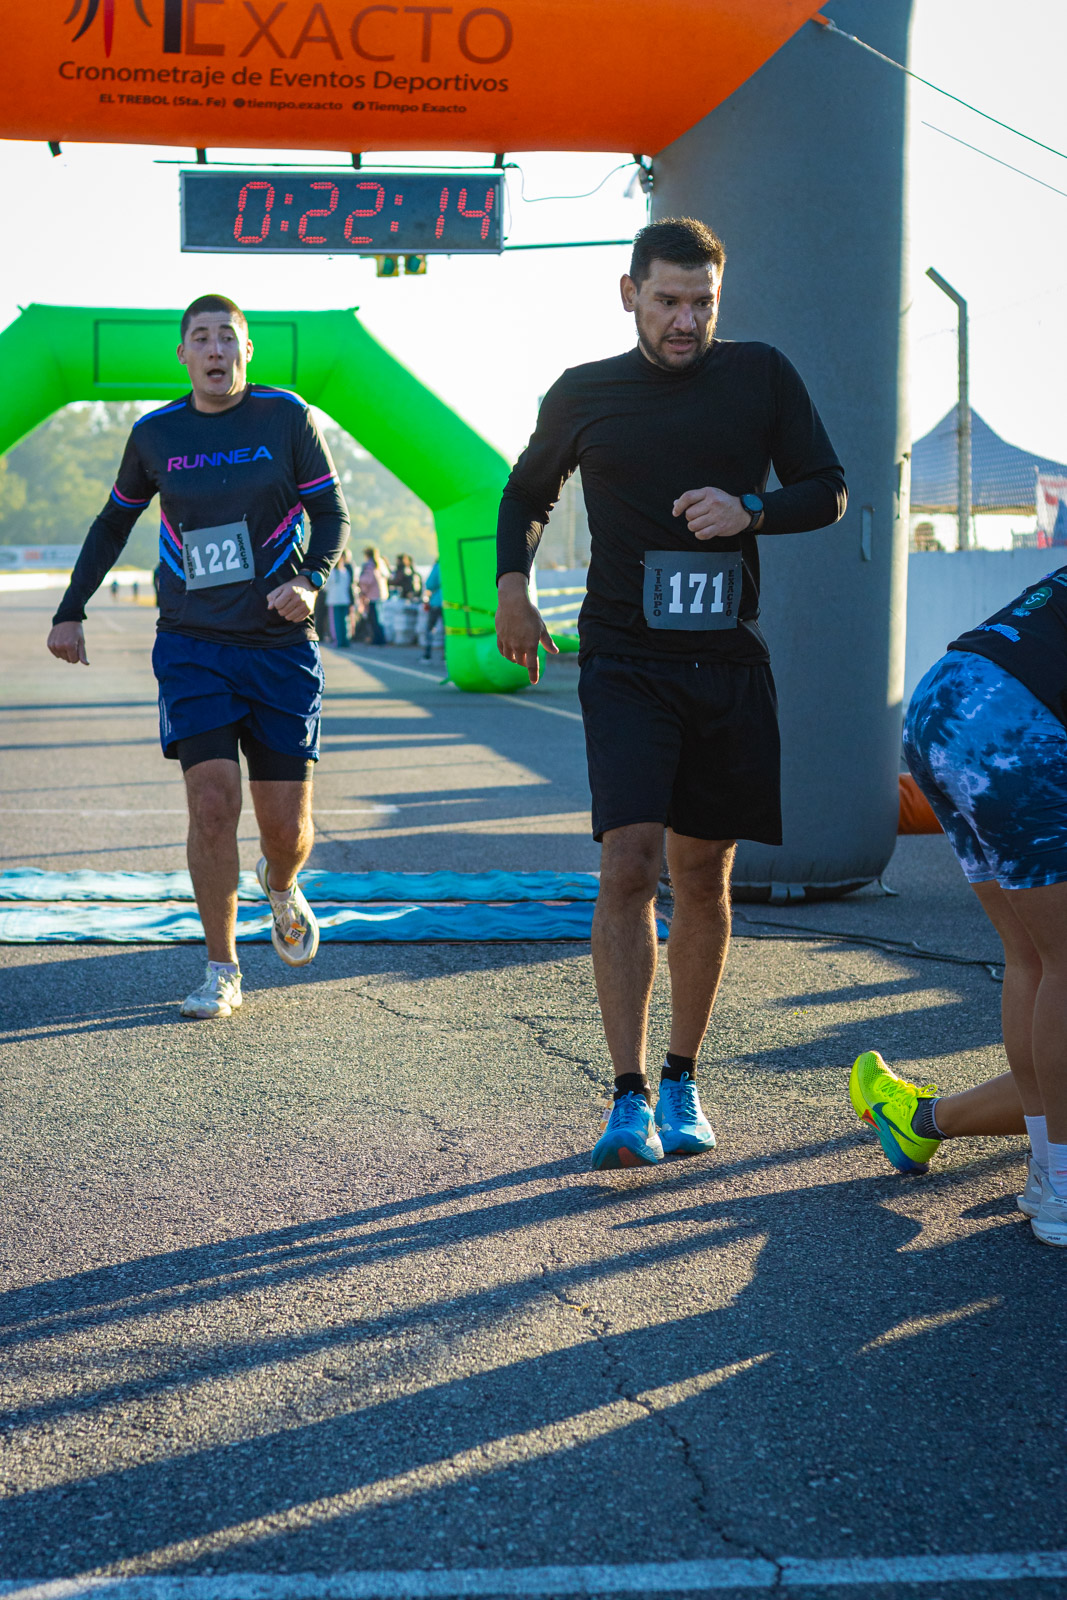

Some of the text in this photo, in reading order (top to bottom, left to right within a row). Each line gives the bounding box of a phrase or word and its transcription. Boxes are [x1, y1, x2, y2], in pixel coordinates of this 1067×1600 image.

[186, 0, 513, 64] EXACTO
[59, 61, 509, 94] Cronometraje de Eventos Deportivos
[100, 94, 226, 108] EL TREBOL (Sta. Fe)
[247, 99, 343, 111] tiempo.exacto
[367, 101, 467, 113] Tiempo Exacto
[167, 446, 273, 472] RUNNEA
[185, 544, 194, 580] TIEMPO
[191, 539, 241, 576] 122
[236, 533, 249, 569] EXACTO
[653, 569, 663, 617] TIEMPO
[668, 572, 724, 613] 171
[726, 570, 735, 617] EXACTO
